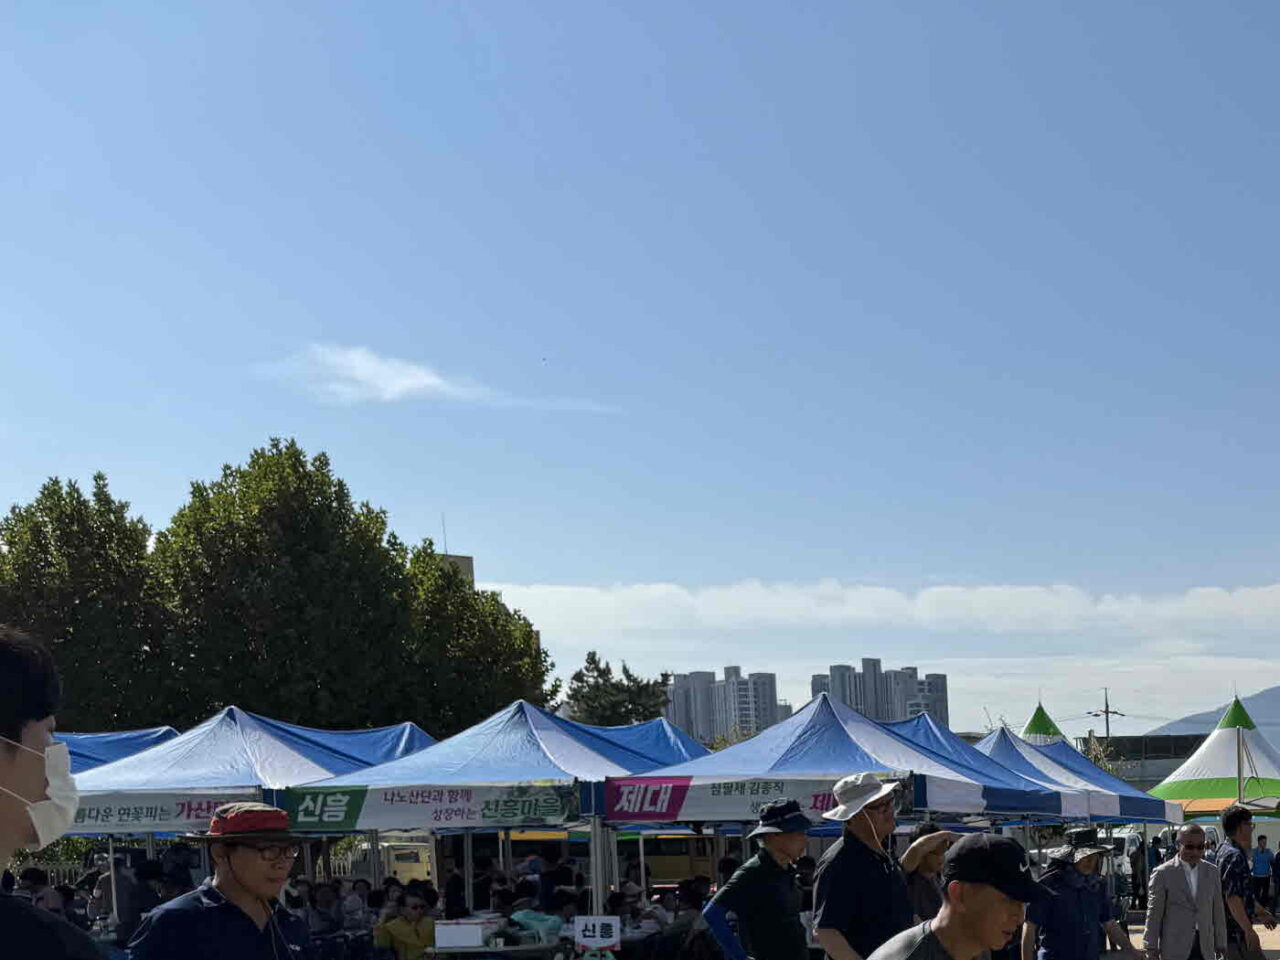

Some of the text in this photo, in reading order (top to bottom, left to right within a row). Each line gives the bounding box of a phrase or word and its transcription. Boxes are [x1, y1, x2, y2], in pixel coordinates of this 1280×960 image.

[297, 794, 350, 822] 신흥
[383, 789, 444, 805] 나노산단과
[480, 796, 562, 821] 신흥마을
[614, 784, 673, 813] 제대
